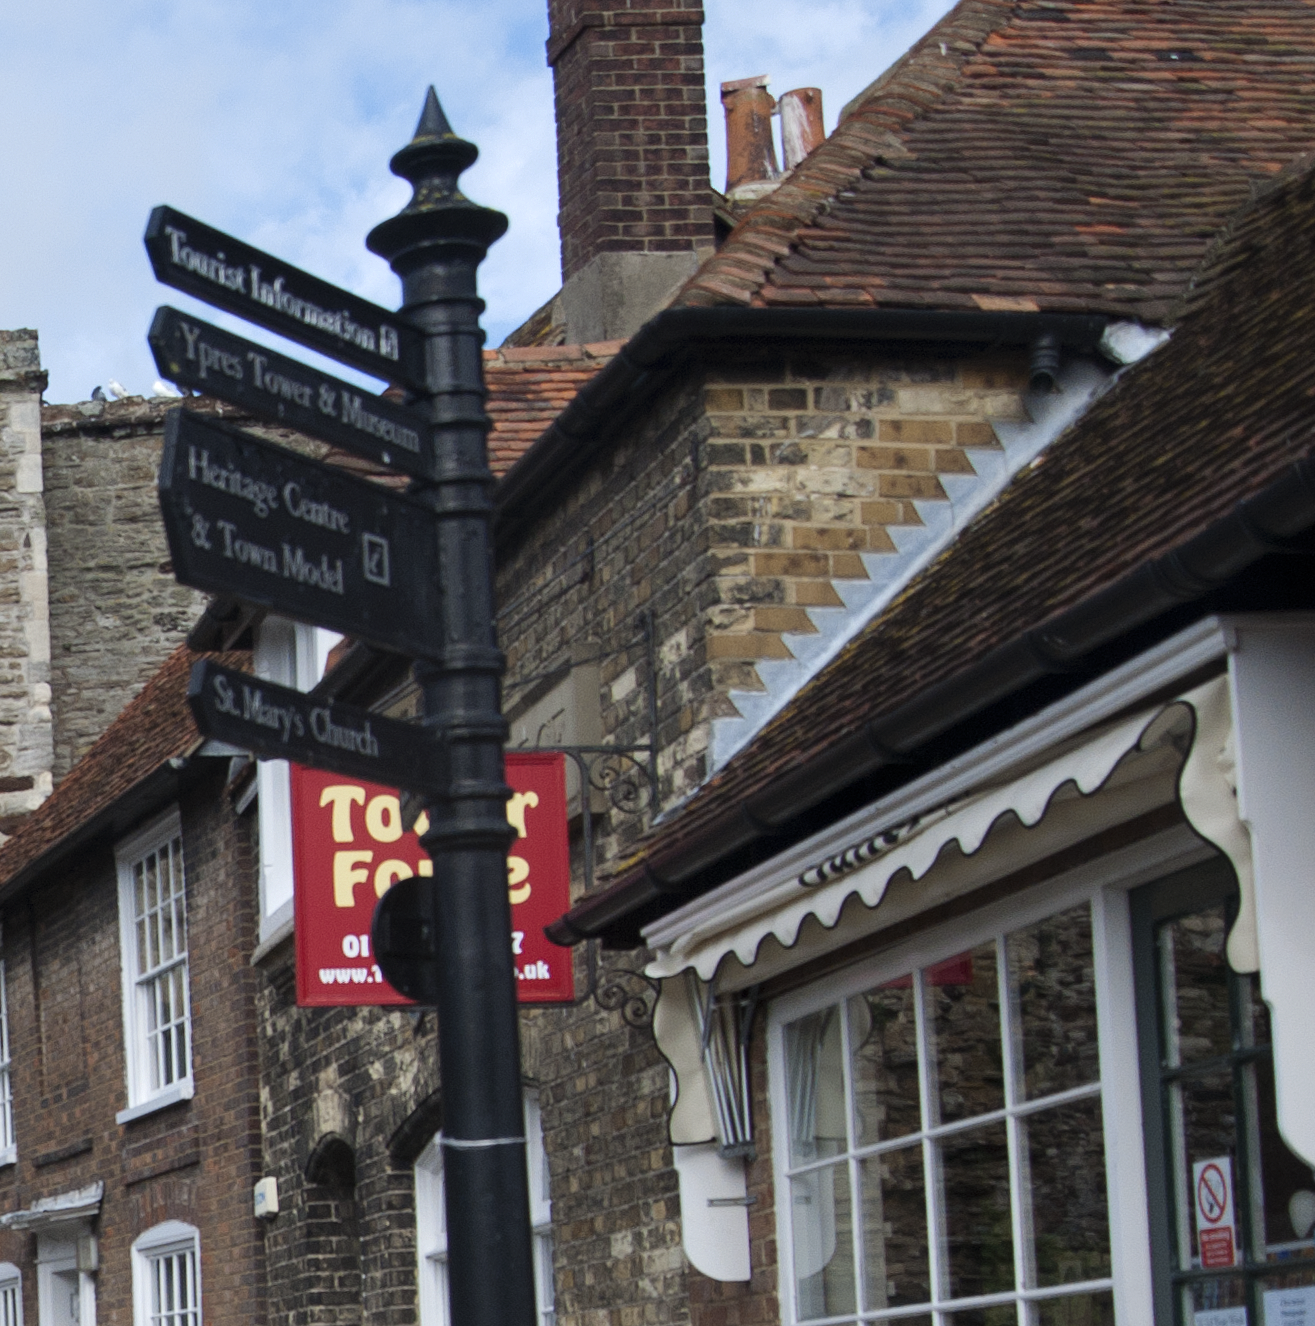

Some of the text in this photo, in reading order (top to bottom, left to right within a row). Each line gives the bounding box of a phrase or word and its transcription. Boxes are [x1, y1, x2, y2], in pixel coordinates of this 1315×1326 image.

[164, 224, 246, 295] Tourist
[249, 263, 376, 352] Information
[179, 321, 421, 453] Ypres Tower & Museum
[187, 445, 351, 535] Heritage Centre
[190, 512, 344, 595] & Town Model
[212, 673, 380, 758] St. Mary's Church
[319, 784, 540, 843] Tor
[333, 850, 532, 908] Foe
